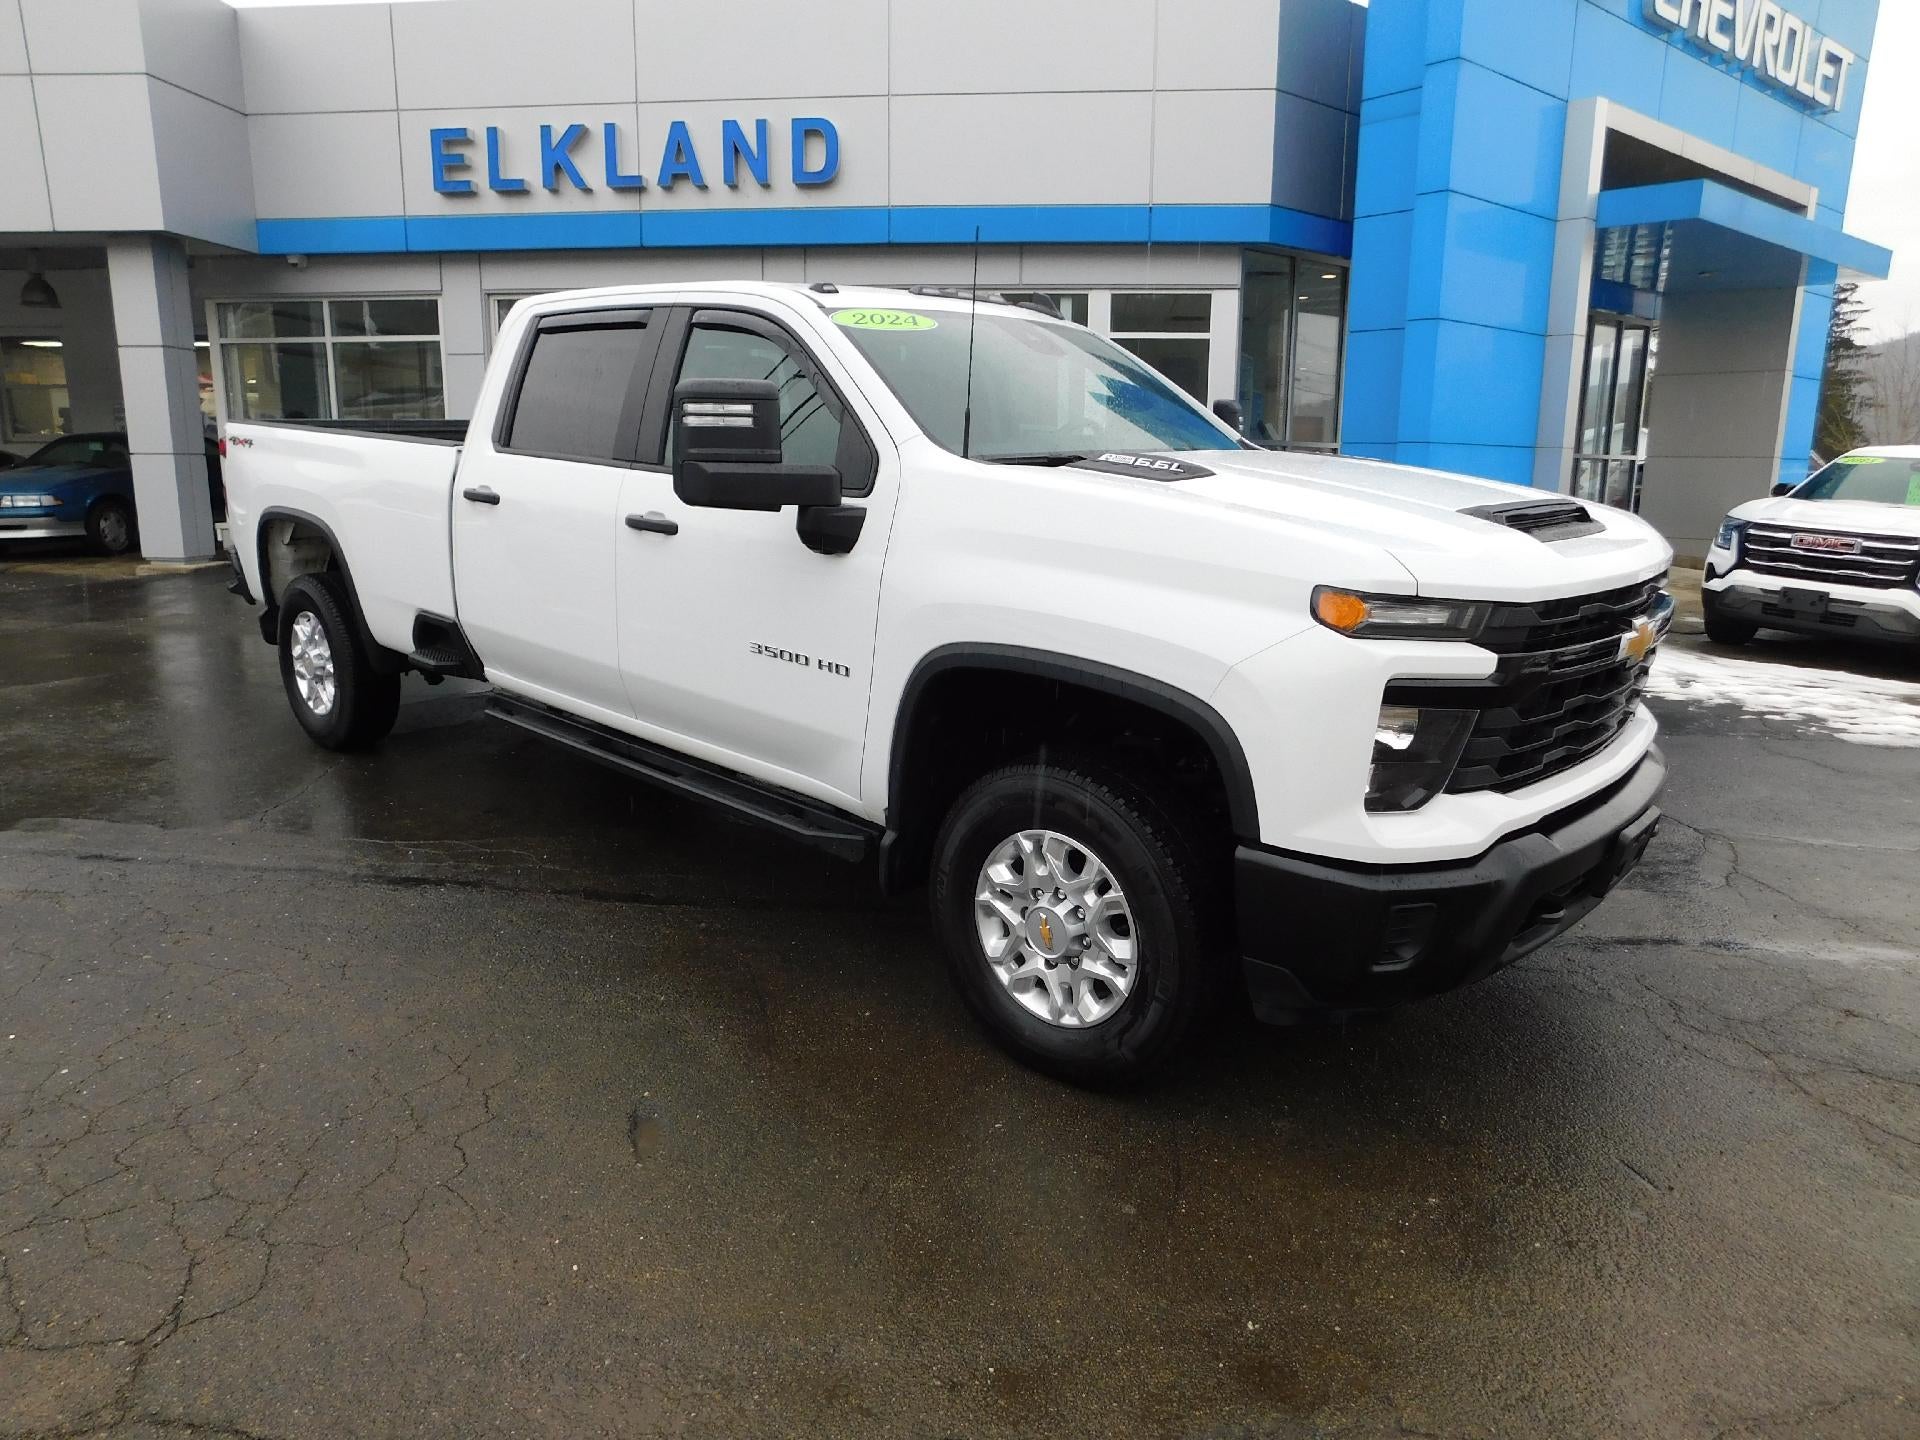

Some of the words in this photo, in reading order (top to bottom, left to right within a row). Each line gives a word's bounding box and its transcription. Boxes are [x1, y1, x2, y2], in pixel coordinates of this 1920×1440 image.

[1654, 0, 1854, 111] EVROLET
[430, 117, 841, 195] ELKLAND
[852, 312, 920, 327] 2024
[1133, 457, 1185, 474] 6.6L
[1796, 534, 1857, 553] GMC
[748, 640, 811, 667] 3500
[817, 658, 851, 678] HD
